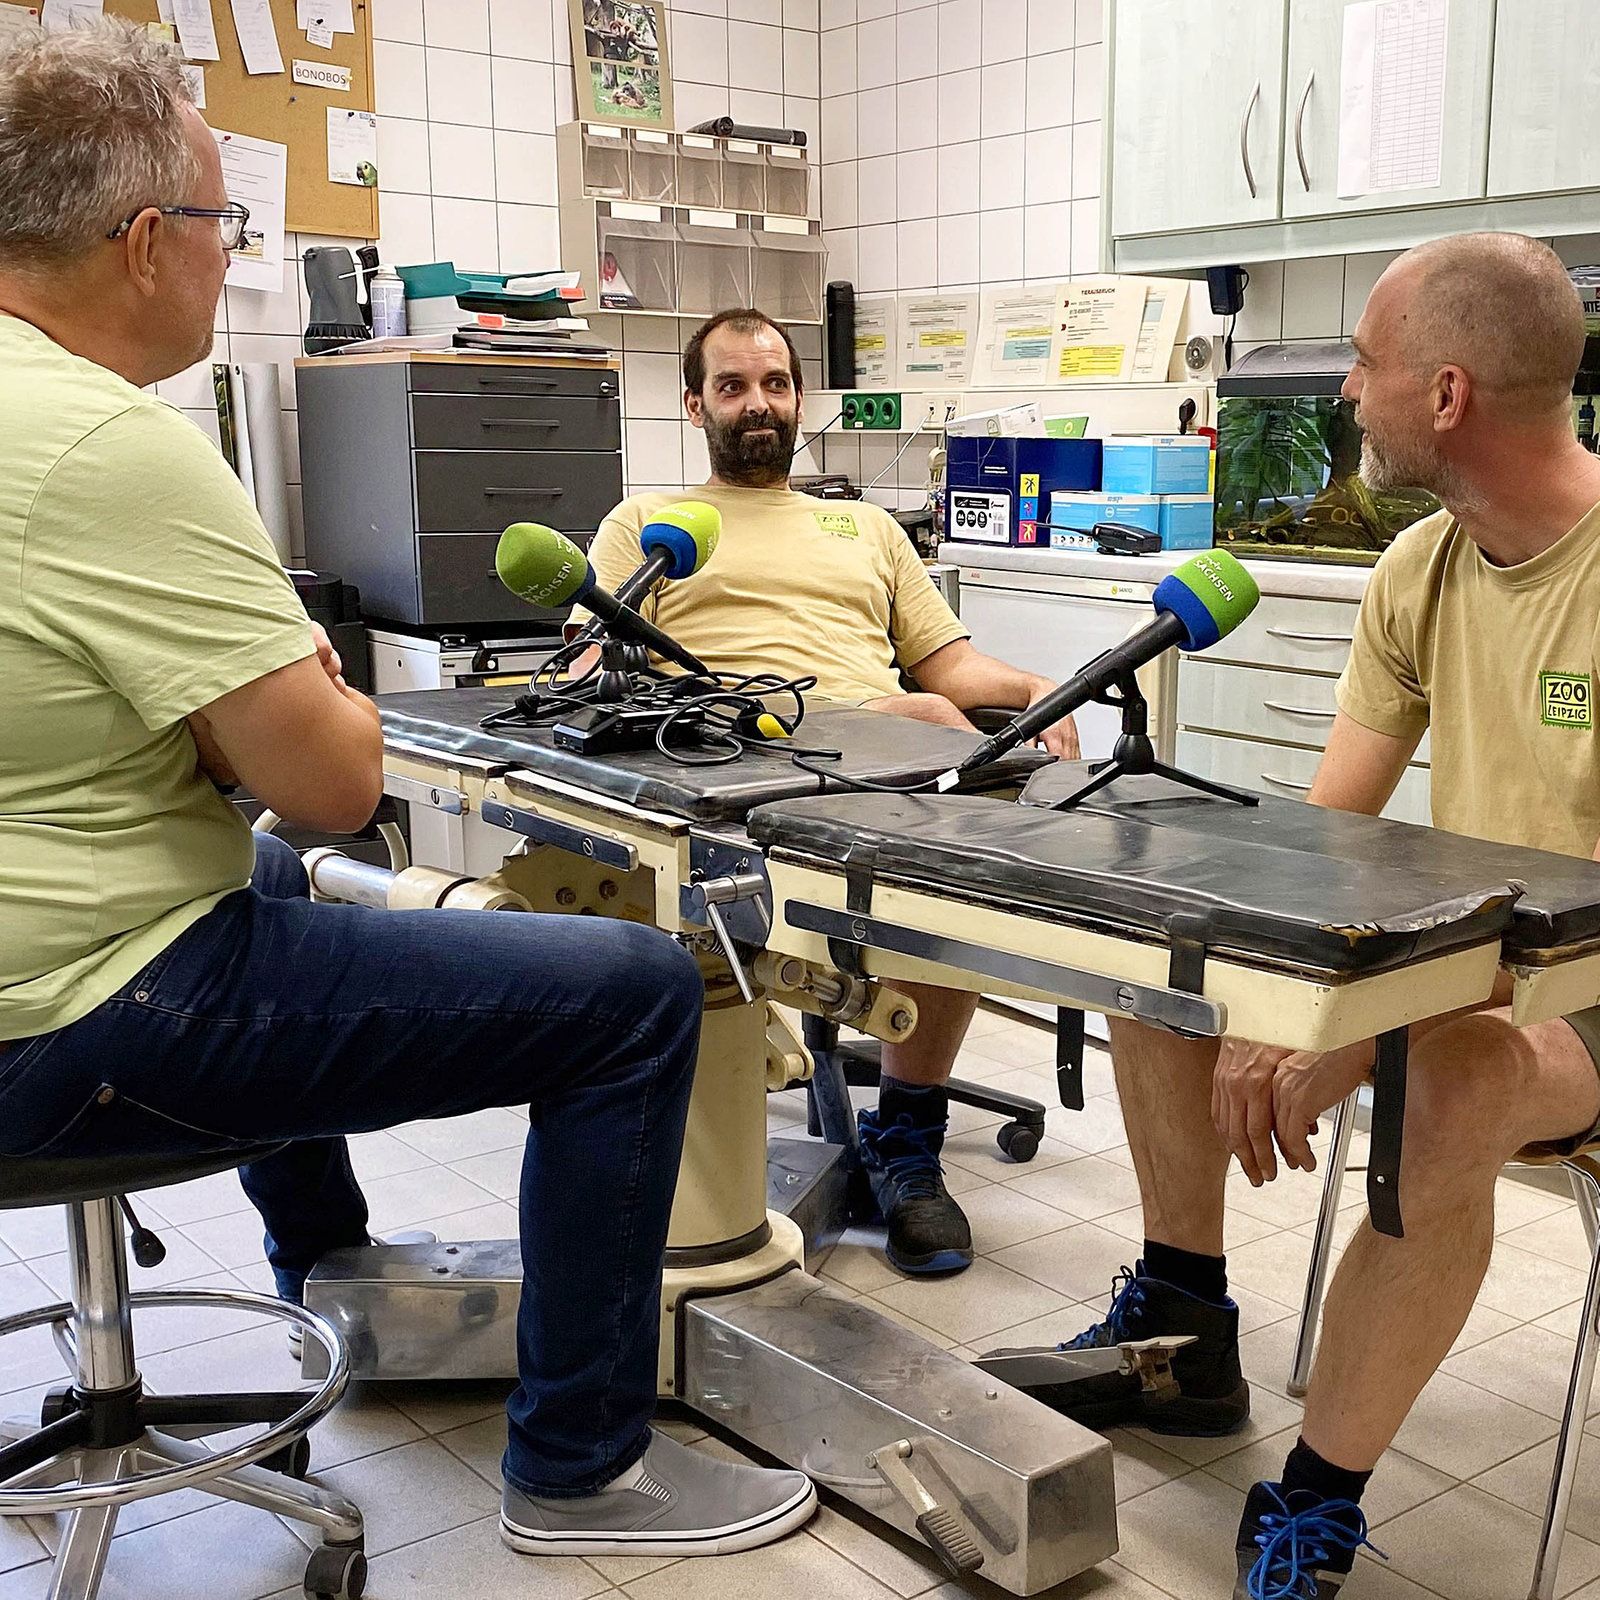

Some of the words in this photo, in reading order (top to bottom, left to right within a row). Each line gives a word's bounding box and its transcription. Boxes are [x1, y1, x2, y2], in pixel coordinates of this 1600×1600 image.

[295, 67, 346, 85] BONOBOS
[1193, 560, 1235, 602] SACHSEN
[1548, 681, 1587, 702] ZOO
[1547, 704, 1587, 720] LEIPZIG
